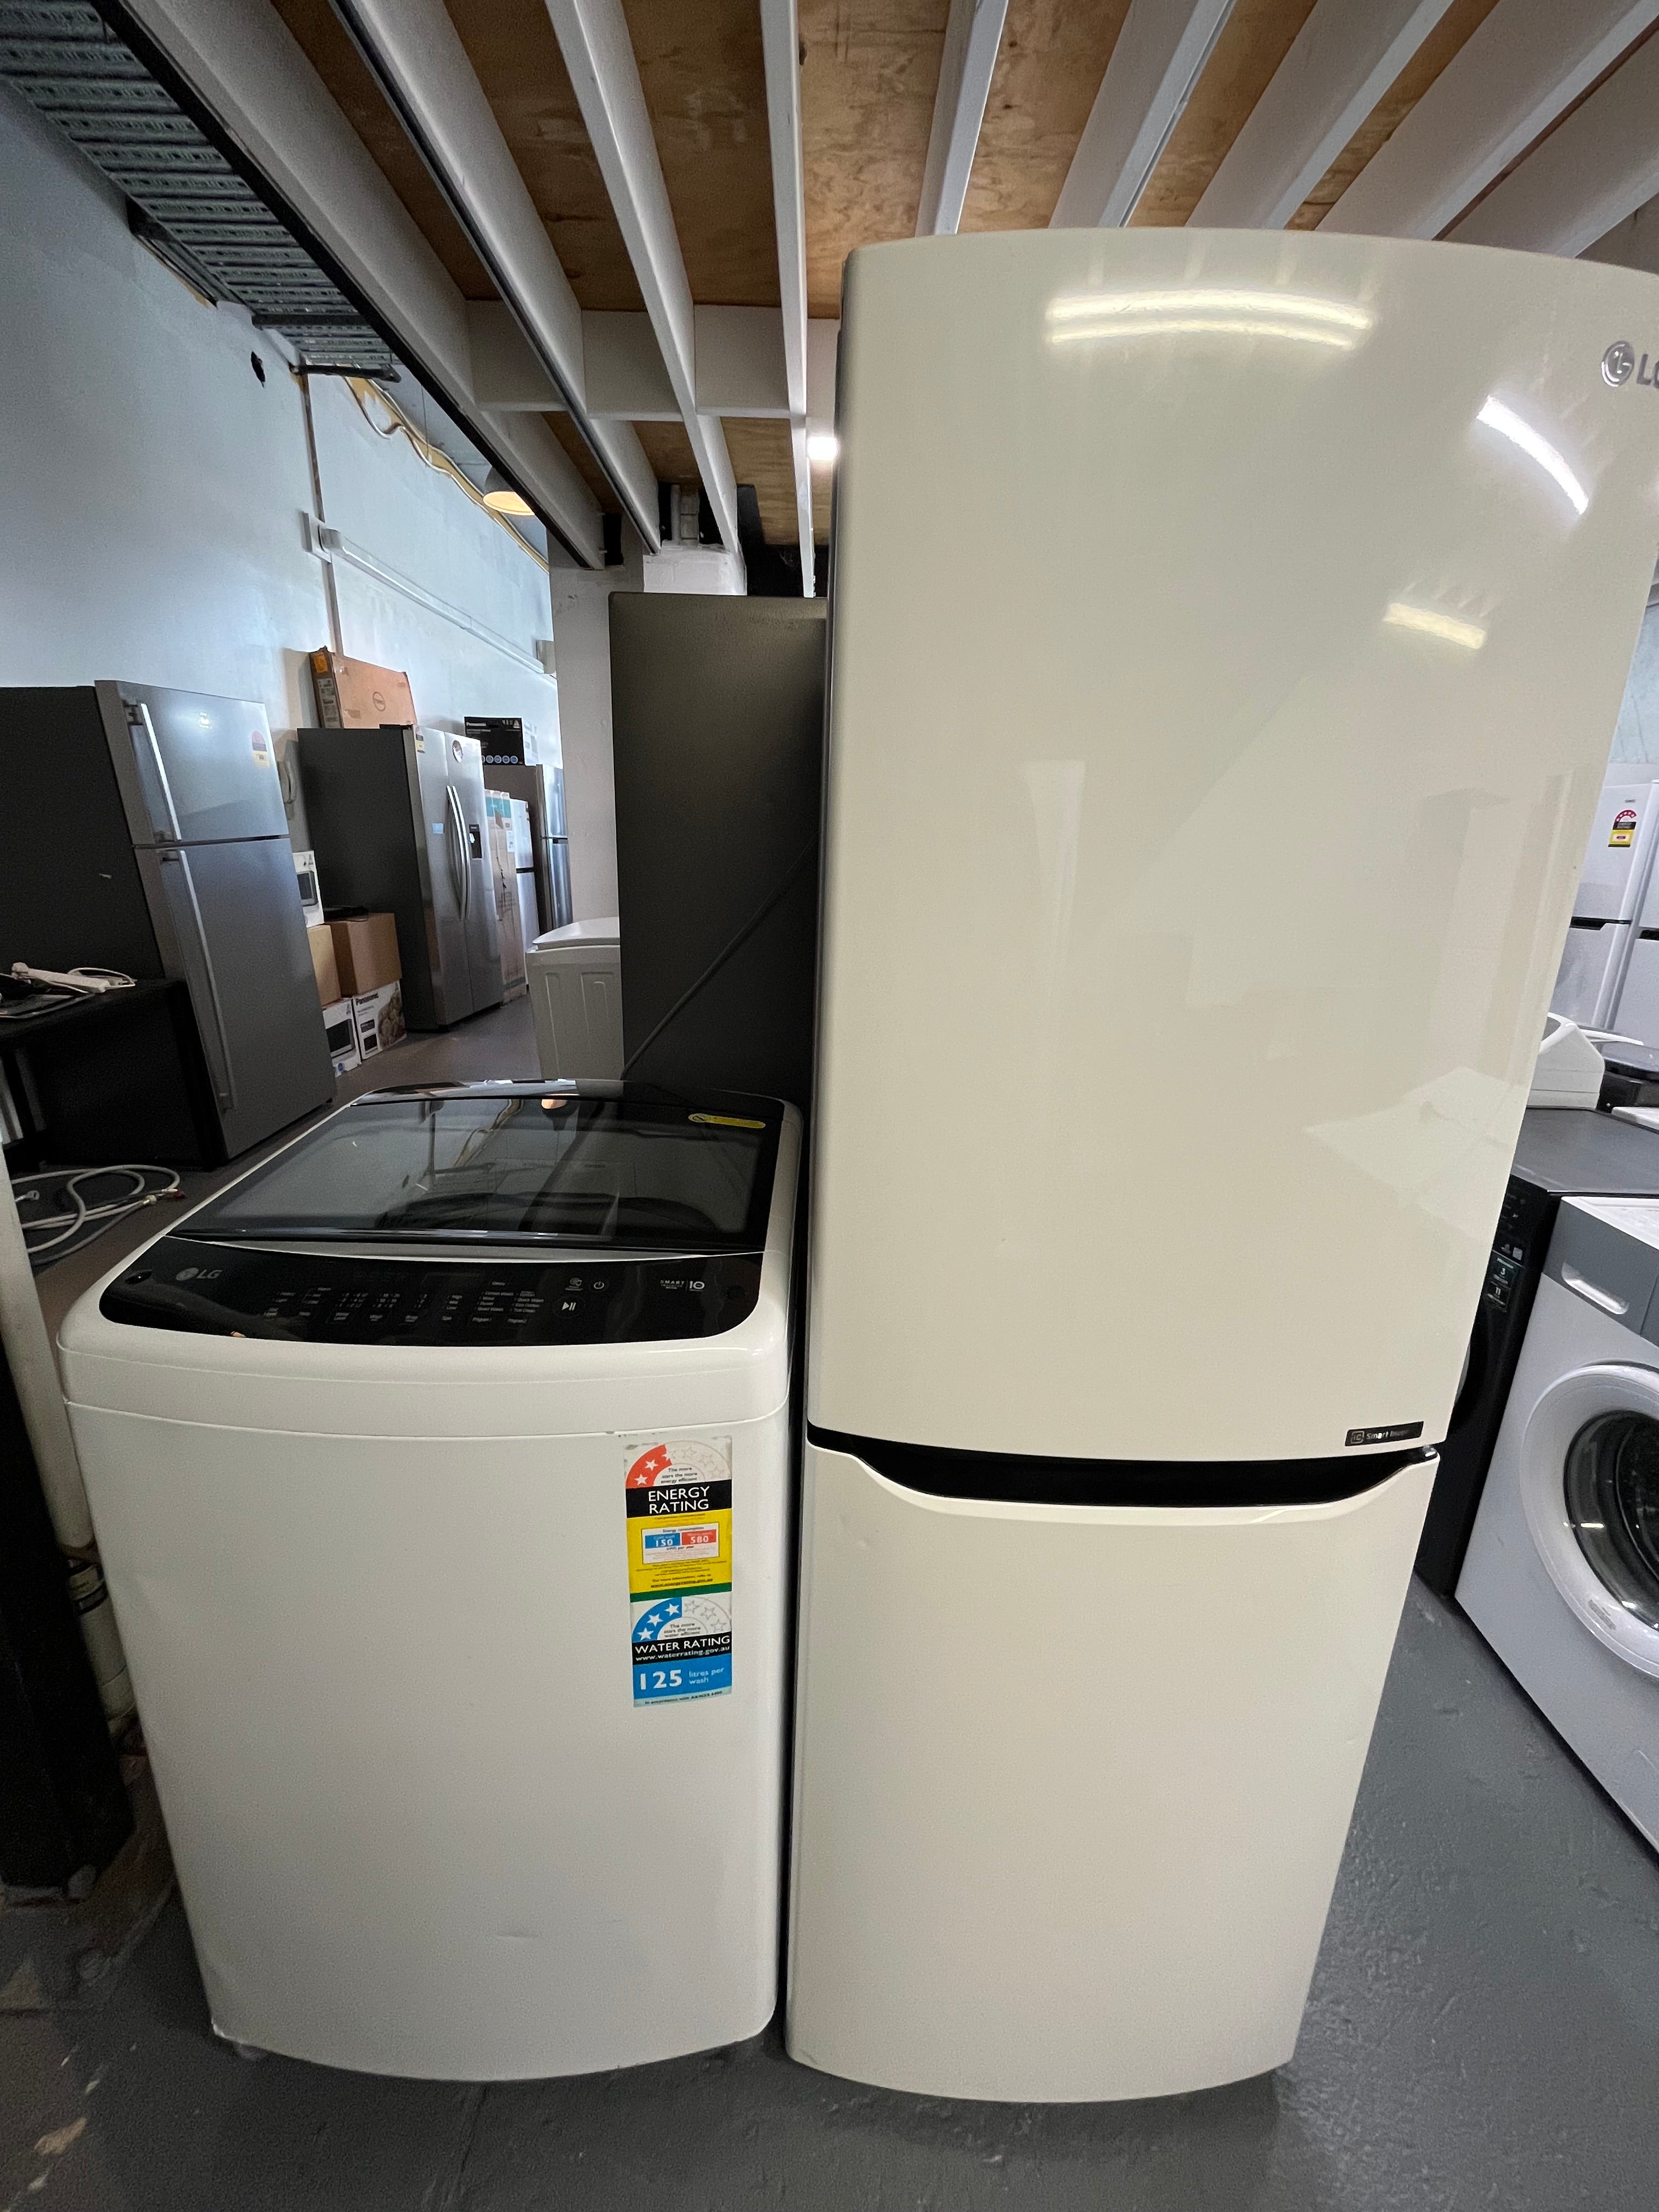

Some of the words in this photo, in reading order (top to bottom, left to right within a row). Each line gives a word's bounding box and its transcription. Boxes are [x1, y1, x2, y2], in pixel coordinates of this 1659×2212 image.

[196, 1269, 223, 1279] LG
[648, 1486, 710, 1502] ENERGY
[649, 1499, 709, 1514] RATING
[690, 1536, 709, 1544] 580
[635, 1641, 680, 1654] WATER
[684, 1635, 730, 1649] RATING
[635, 1646, 730, 1661] www.waterrating.gov.au
[711, 1667, 725, 1675] per
[640, 1669, 682, 1690] 125
